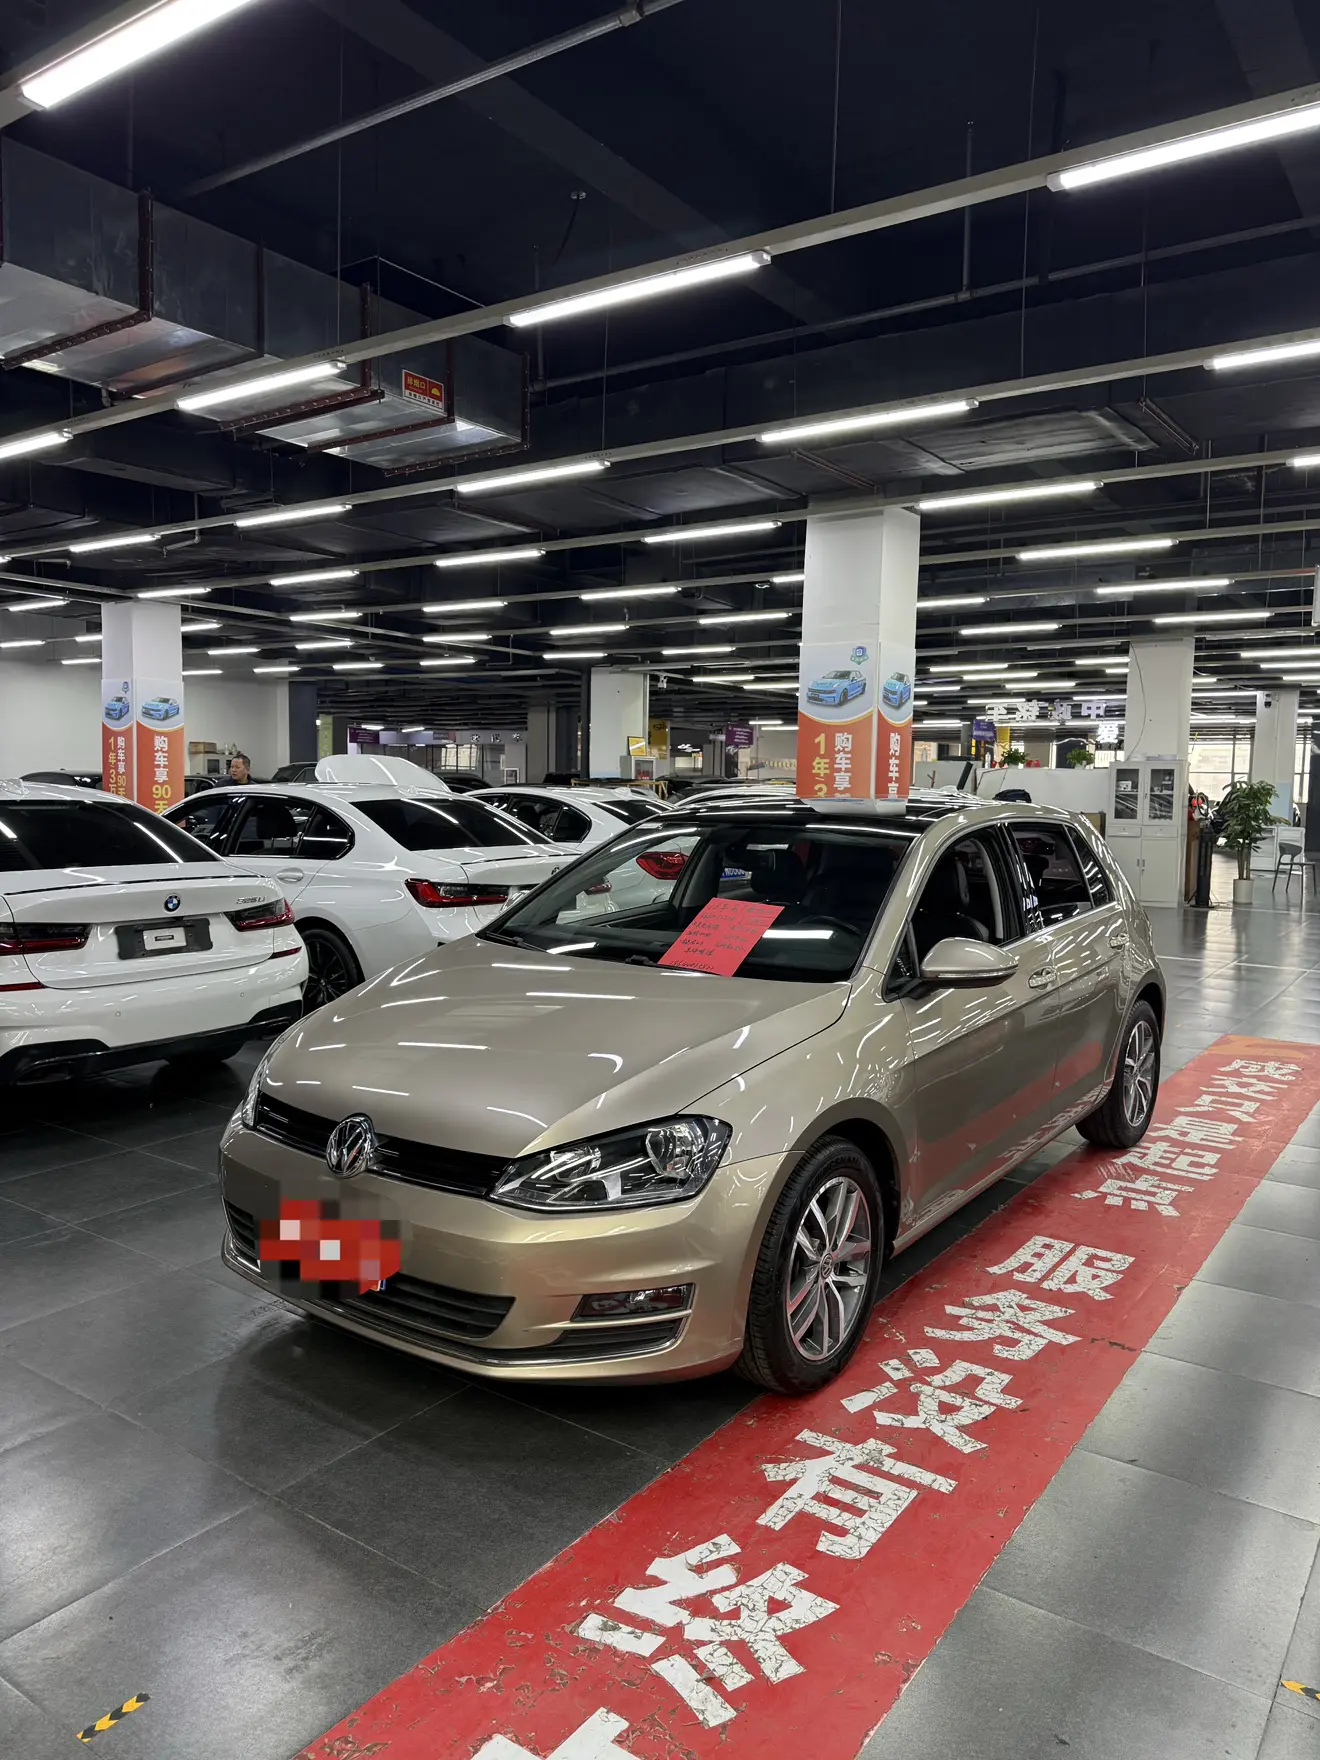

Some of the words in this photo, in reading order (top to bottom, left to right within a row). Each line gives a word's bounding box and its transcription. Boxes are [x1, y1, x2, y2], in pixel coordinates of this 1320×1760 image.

[833, 732, 853, 797] 购车享
[1070, 1058, 1305, 1217] 成交只是起点
